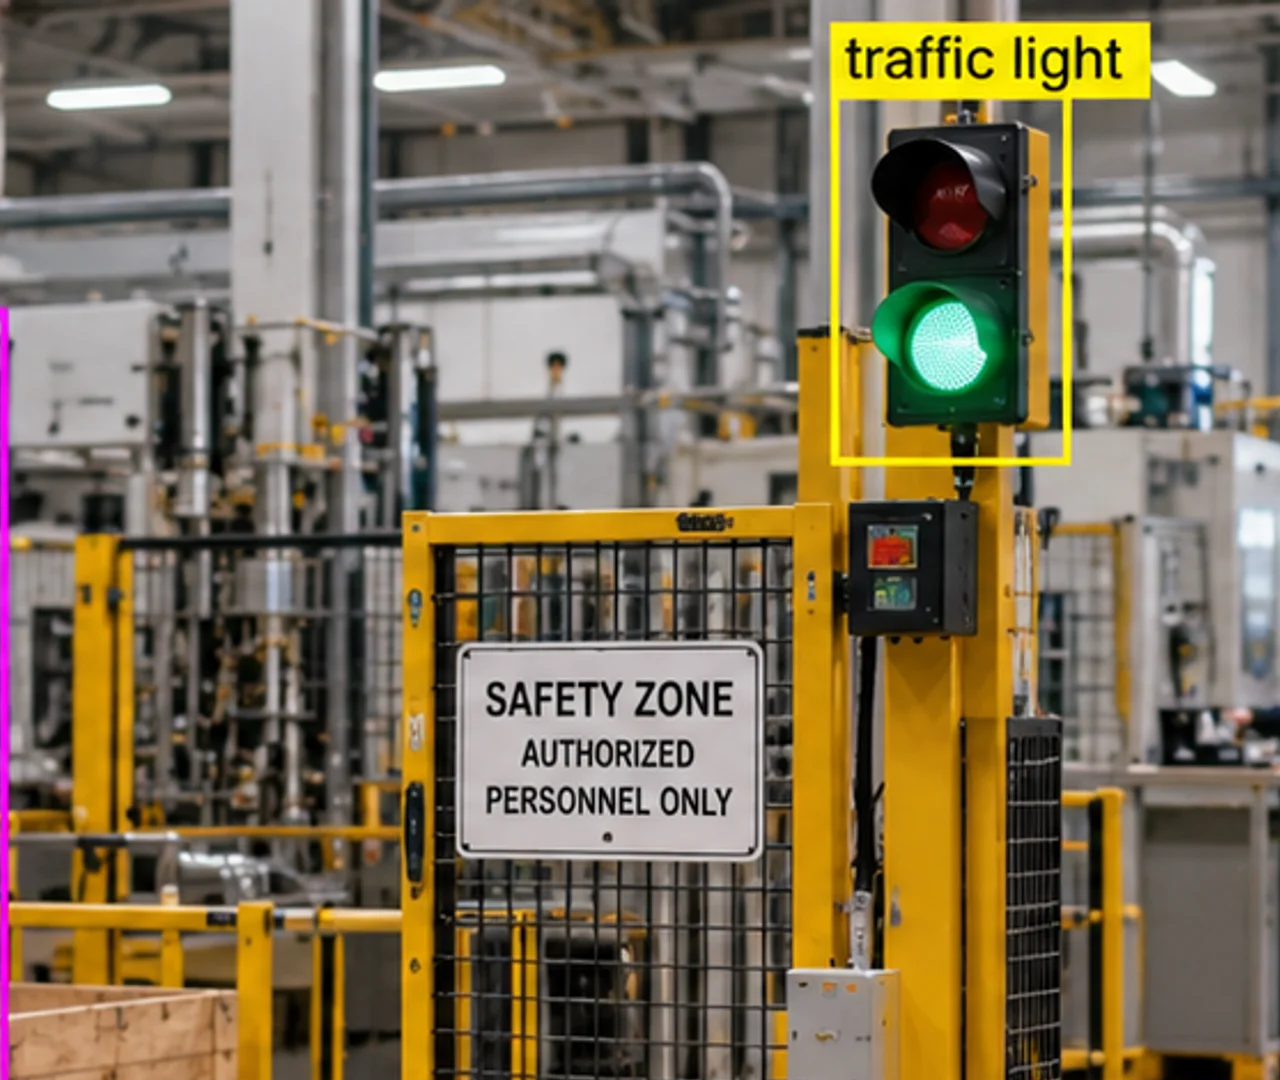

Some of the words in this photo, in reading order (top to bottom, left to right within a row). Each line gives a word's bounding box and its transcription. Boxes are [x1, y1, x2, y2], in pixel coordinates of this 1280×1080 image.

[485, 680, 623, 718] SAFETY
[634, 680, 734, 718] ZONE
[521, 738, 695, 768] AUTHORIZED
[486, 785, 651, 816] PERSONNEL
[660, 786, 733, 817] ONLY
